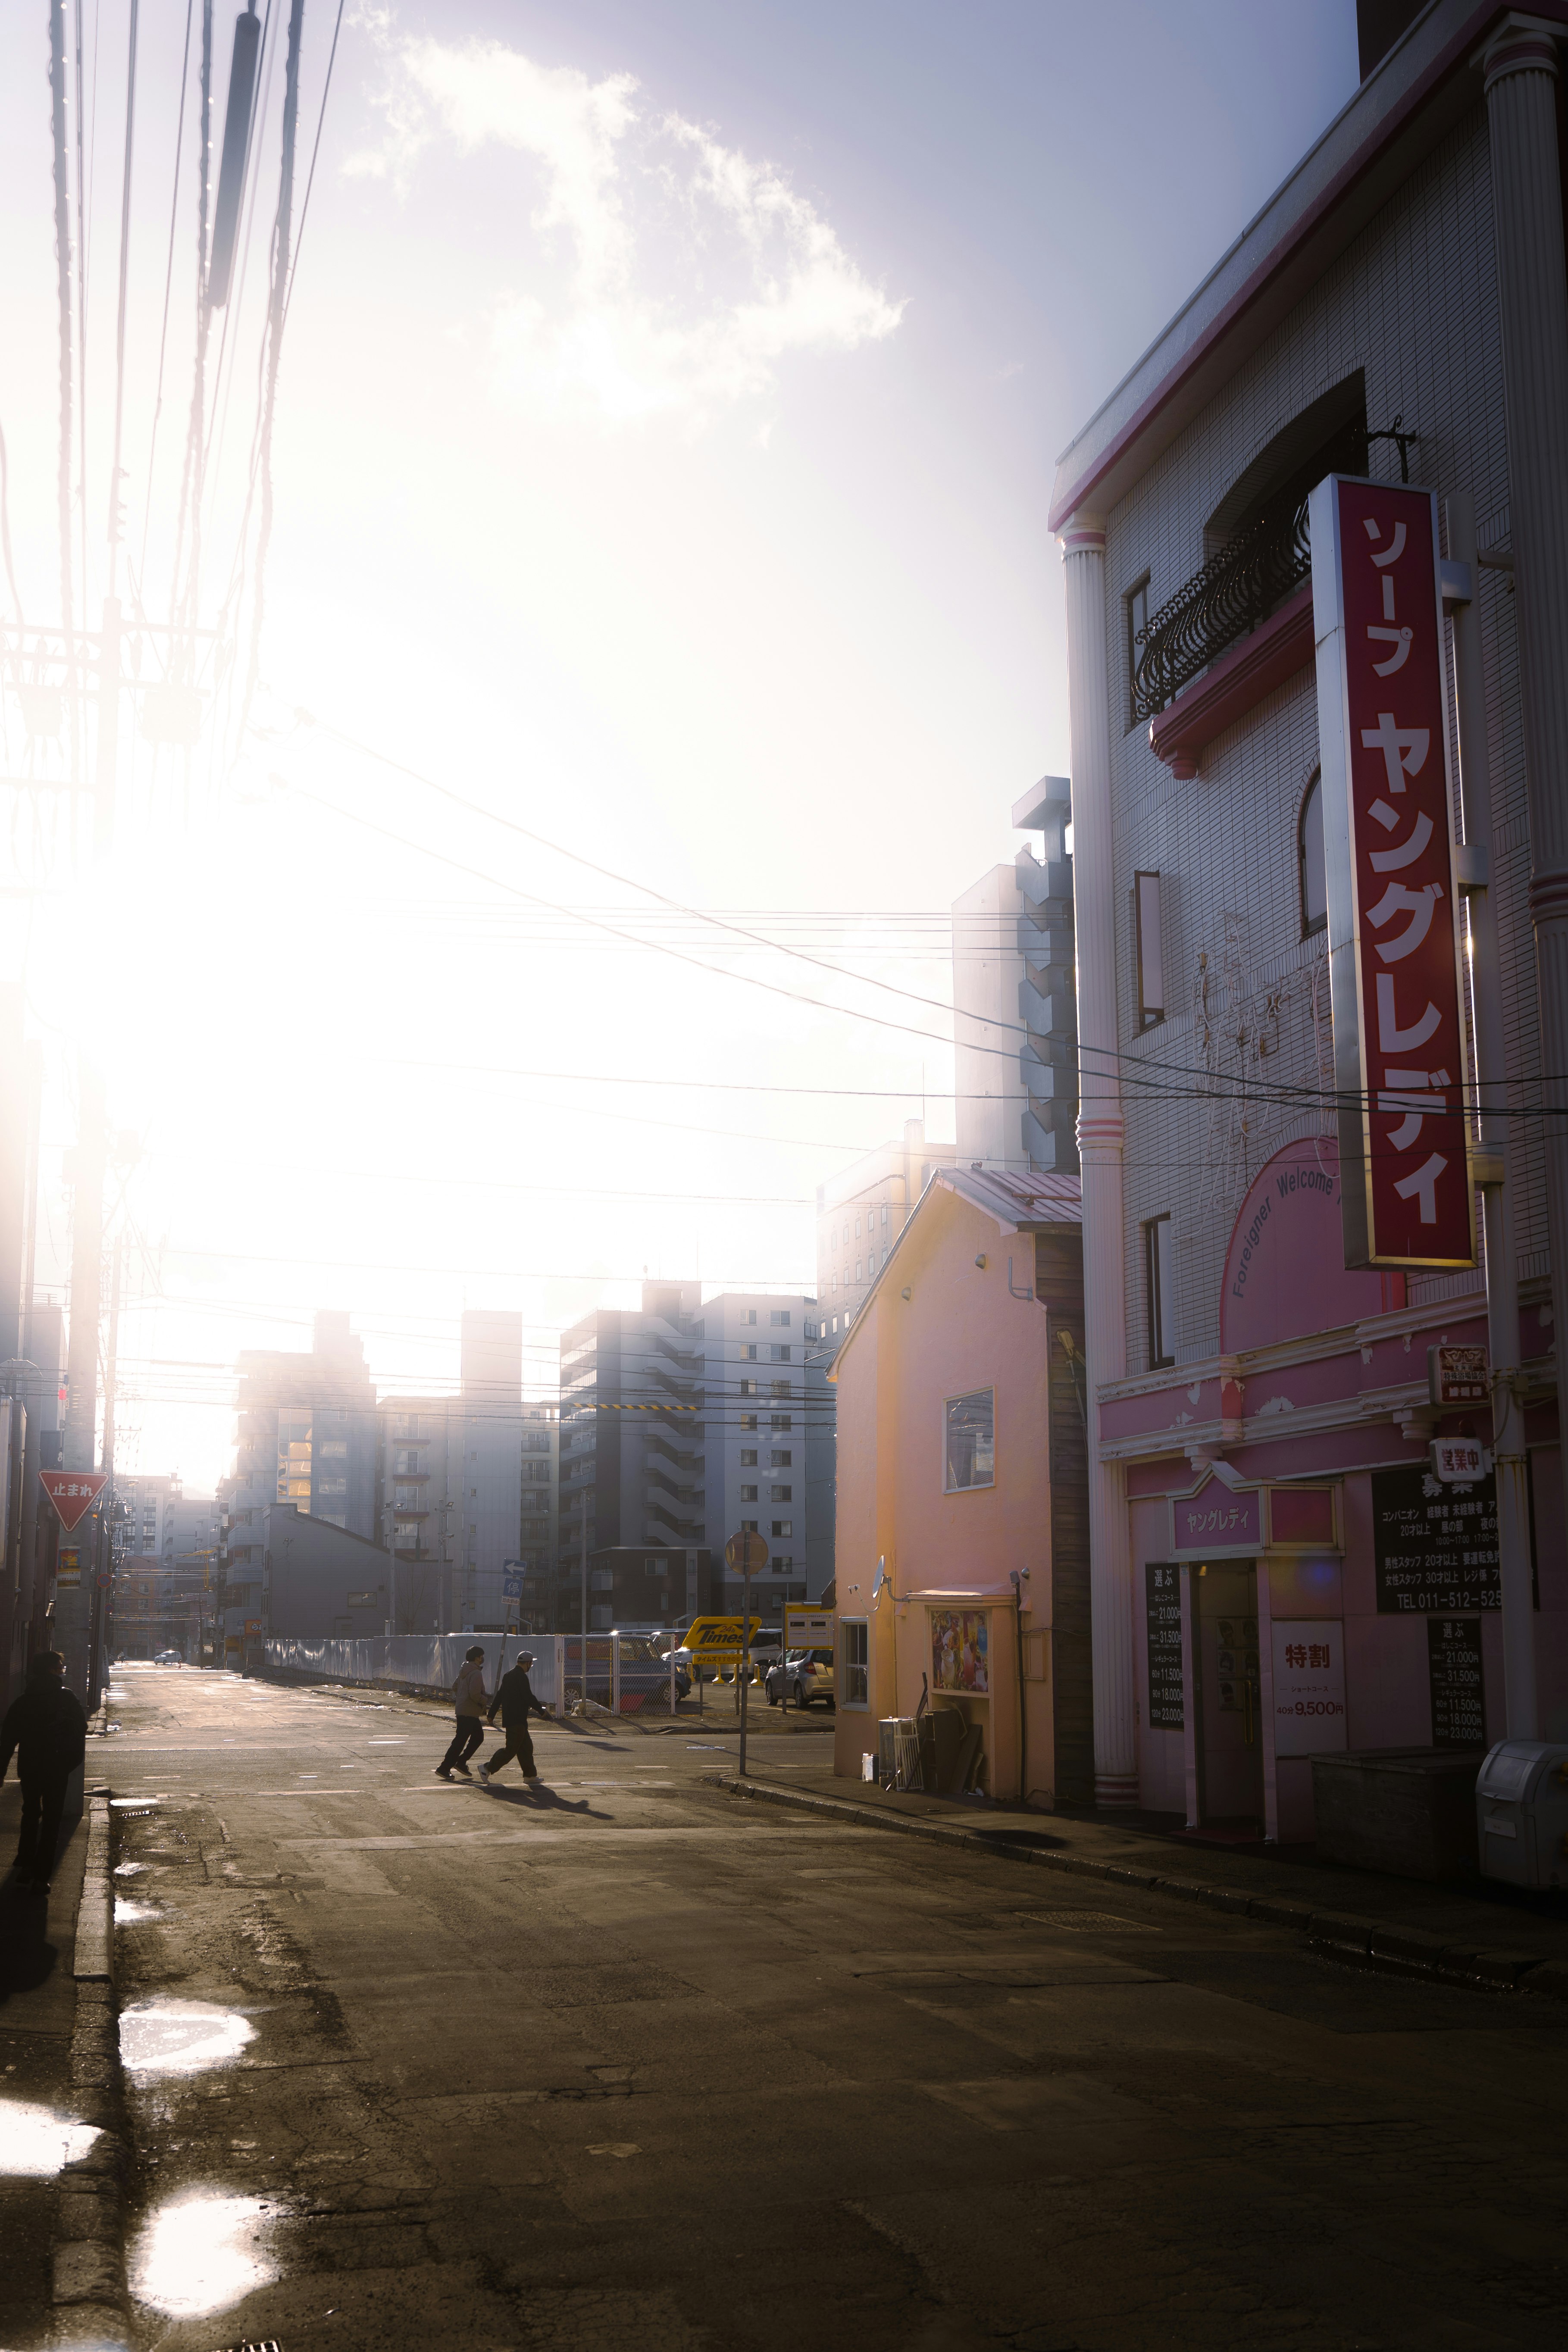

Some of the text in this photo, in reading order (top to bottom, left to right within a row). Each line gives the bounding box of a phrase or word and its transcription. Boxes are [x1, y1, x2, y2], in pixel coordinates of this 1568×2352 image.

[1360, 517, 1452, 1224] ソープ ヤングレディ
[1233, 1166, 1333, 1298] Foreigner Welcome
[1441, 1448, 1479, 1471] 営業中
[52, 1482, 93, 1497] 止まれ
[1383, 1501, 1498, 1522] コンパニオン 経験者 未経験者 ア
[1187, 1507, 1249, 1534] ヤングレディ
[1400, 1523, 1430, 1536] 20才以上
[1441, 1520, 1463, 1533] 昼の部
[1385, 1556, 1421, 1570] 男性スタッフ
[1425, 1552, 1458, 1567] 20才以上
[1155, 1569, 1173, 1587] 選ぶ
[1385, 1573, 1421, 1586] 女性スタッフ
[1426, 1570, 1458, 1584] 30才以上
[1464, 1569, 1487, 1582] レジ係
[507, 1581, 519, 1594] 停
[1397, 1593, 1416, 1609] TEL
[1443, 1622, 1464, 1638] 選ぶ
[1285, 1644, 1330, 1669] 特割
[1152, 1670, 1160, 1678] 60分
[1152, 1689, 1161, 1698] 90分
[1441, 1689, 1471, 1697] レギュラーコース
[1295, 1701, 1343, 1717] 9,500円
[1437, 1714, 1448, 1722] 90分
[1435, 1728, 1449, 1736] 120分
